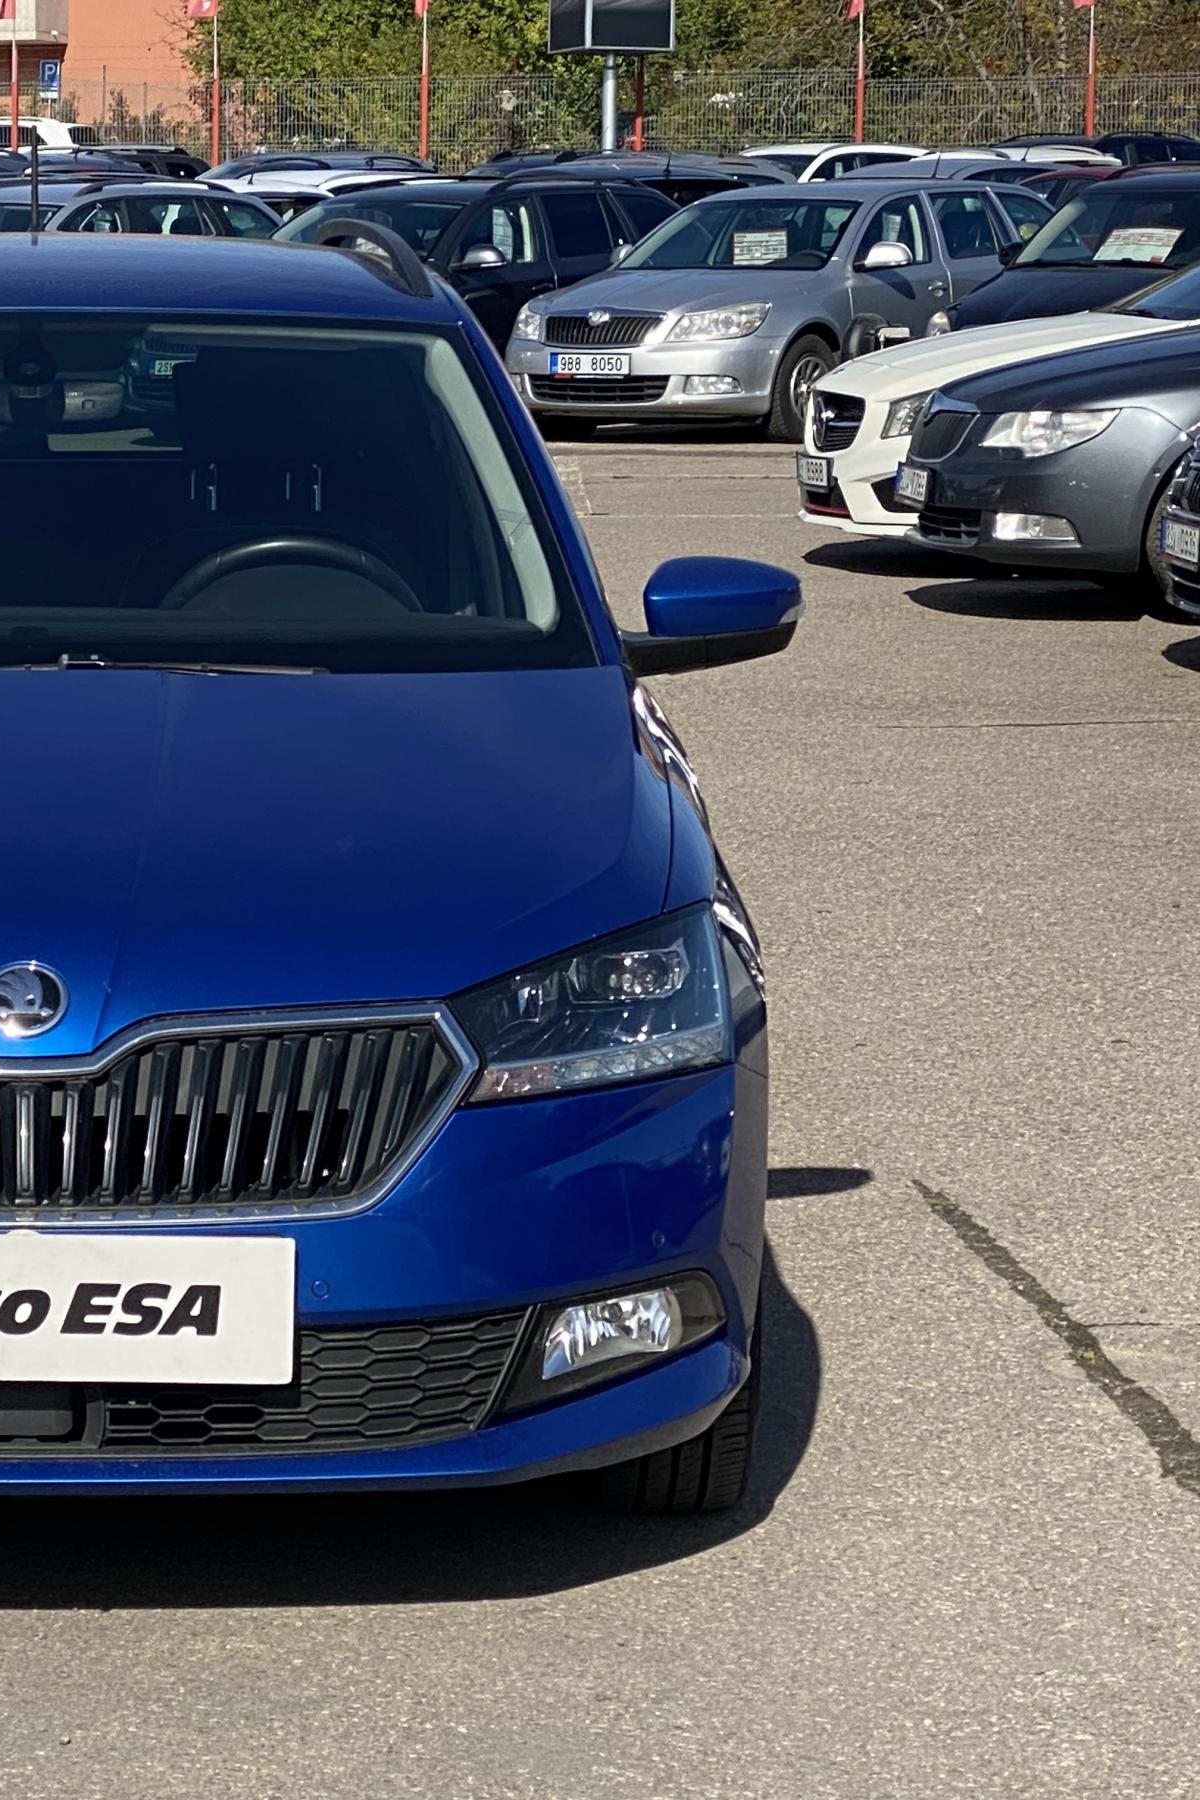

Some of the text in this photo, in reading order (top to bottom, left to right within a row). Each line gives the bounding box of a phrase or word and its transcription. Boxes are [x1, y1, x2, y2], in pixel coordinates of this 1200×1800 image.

[44, 63, 56, 81] P
[591, 356, 623, 371] 8050
[60, 1282, 221, 1336] ESA
